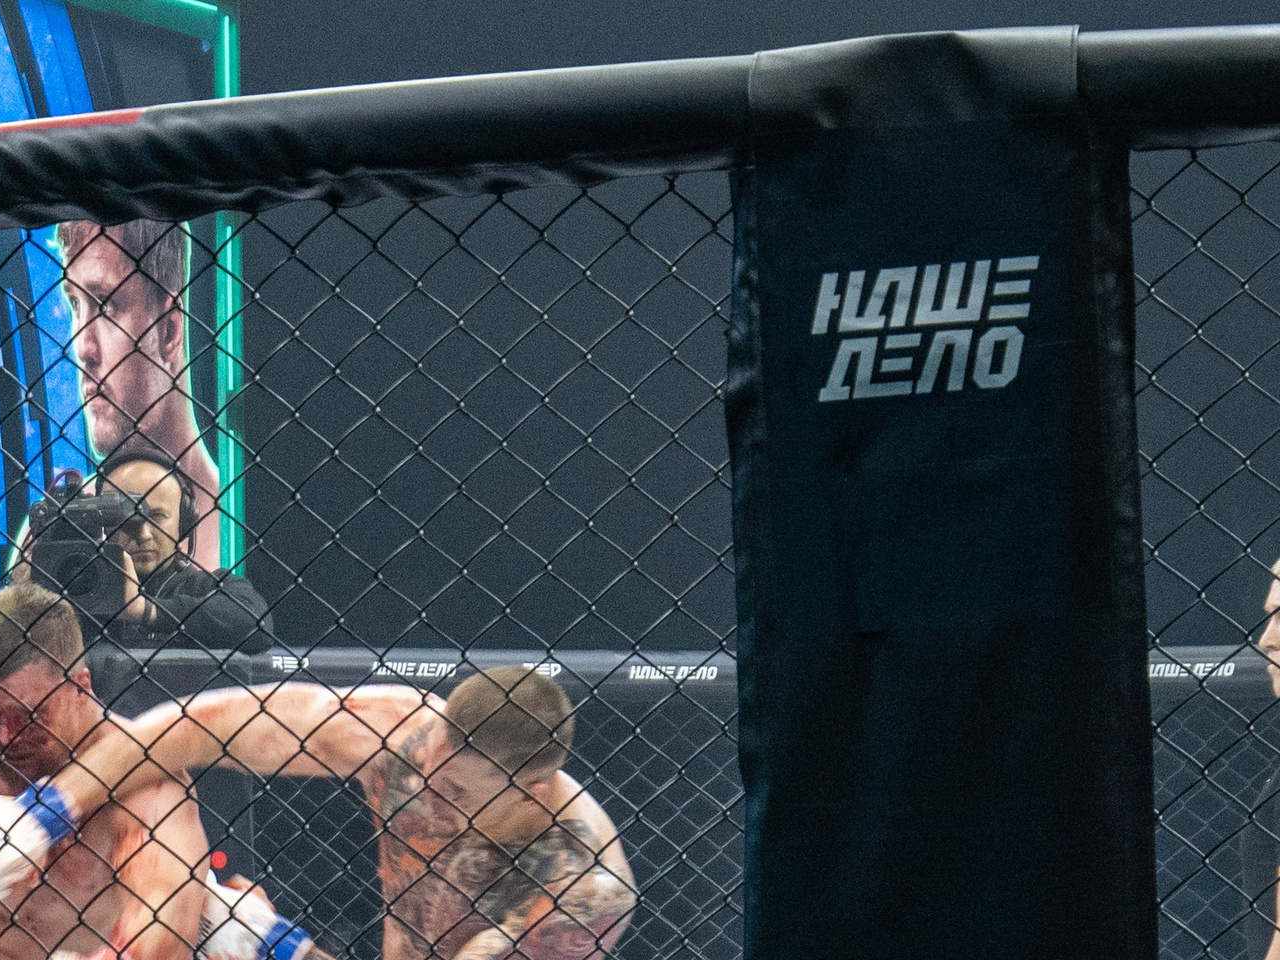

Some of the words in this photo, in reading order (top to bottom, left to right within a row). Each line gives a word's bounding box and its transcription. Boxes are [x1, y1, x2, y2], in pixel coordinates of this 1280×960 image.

[811, 255, 1040, 335] НАШЕ
[818, 325, 1024, 402] ДЕЛО
[1149, 663, 1191, 677] АШЕ
